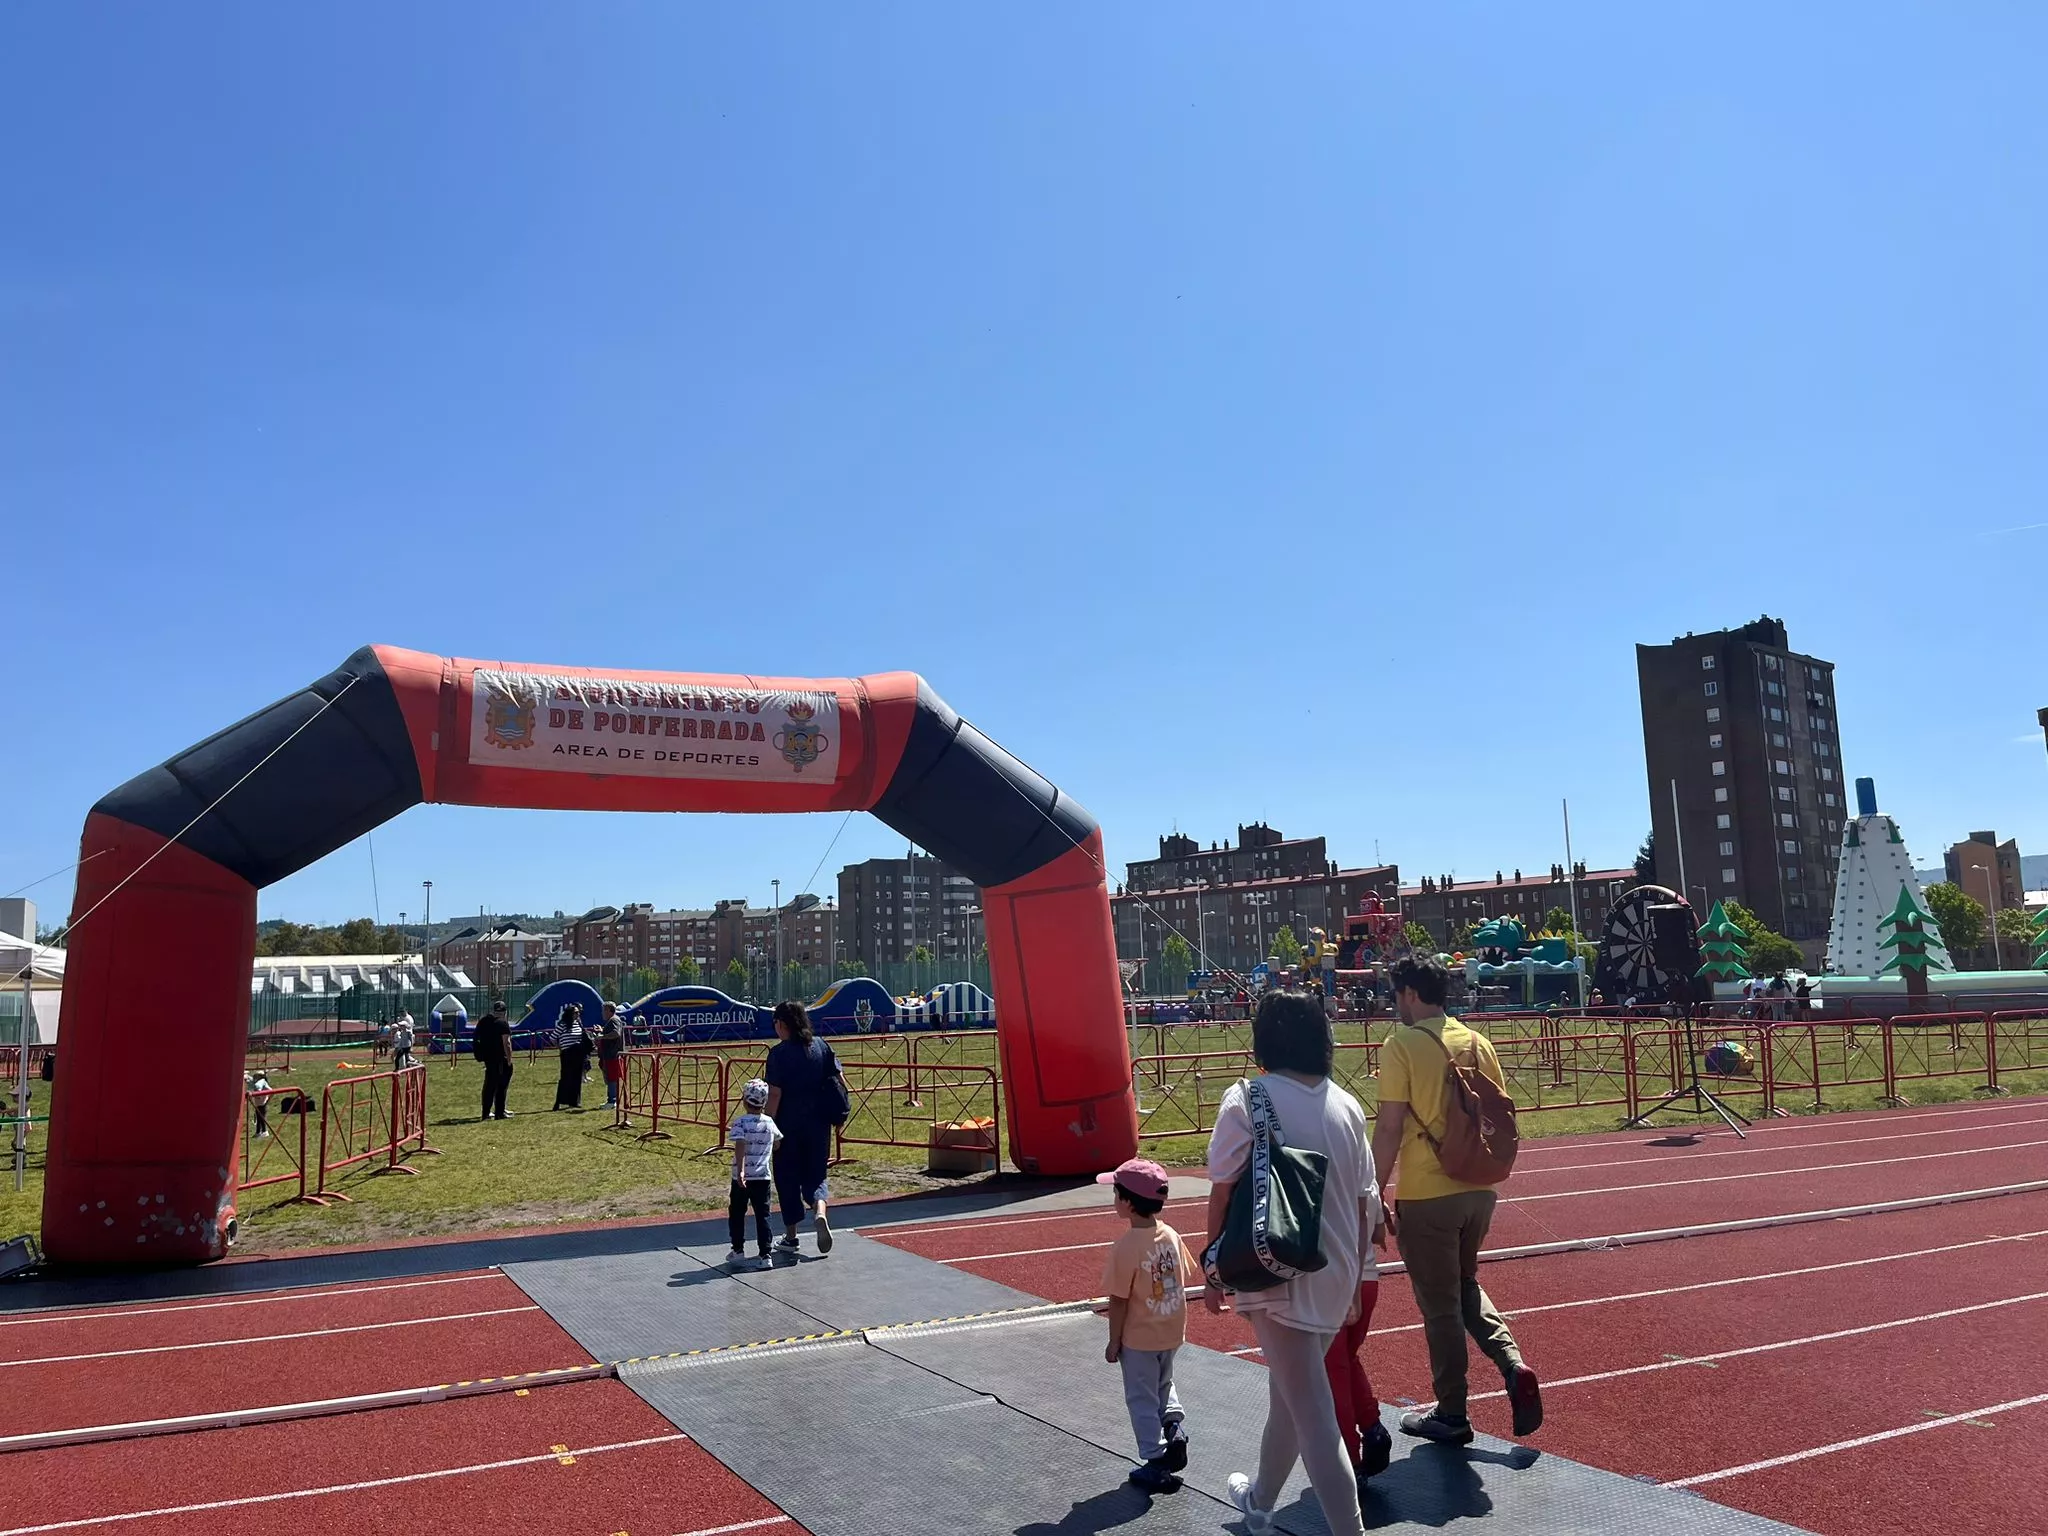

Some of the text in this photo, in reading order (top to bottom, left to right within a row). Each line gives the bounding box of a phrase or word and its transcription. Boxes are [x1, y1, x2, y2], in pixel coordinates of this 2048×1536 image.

[549, 708, 766, 742] DE PONFERRADA
[552, 743, 759, 766] AREA DE DEPORTES
[653, 1010, 755, 1026] PONFERRADINA
[1254, 1121, 1266, 1162] BIMBA
[1256, 1163, 1267, 1172] Y
[1256, 1177, 1267, 1210] LOLA
